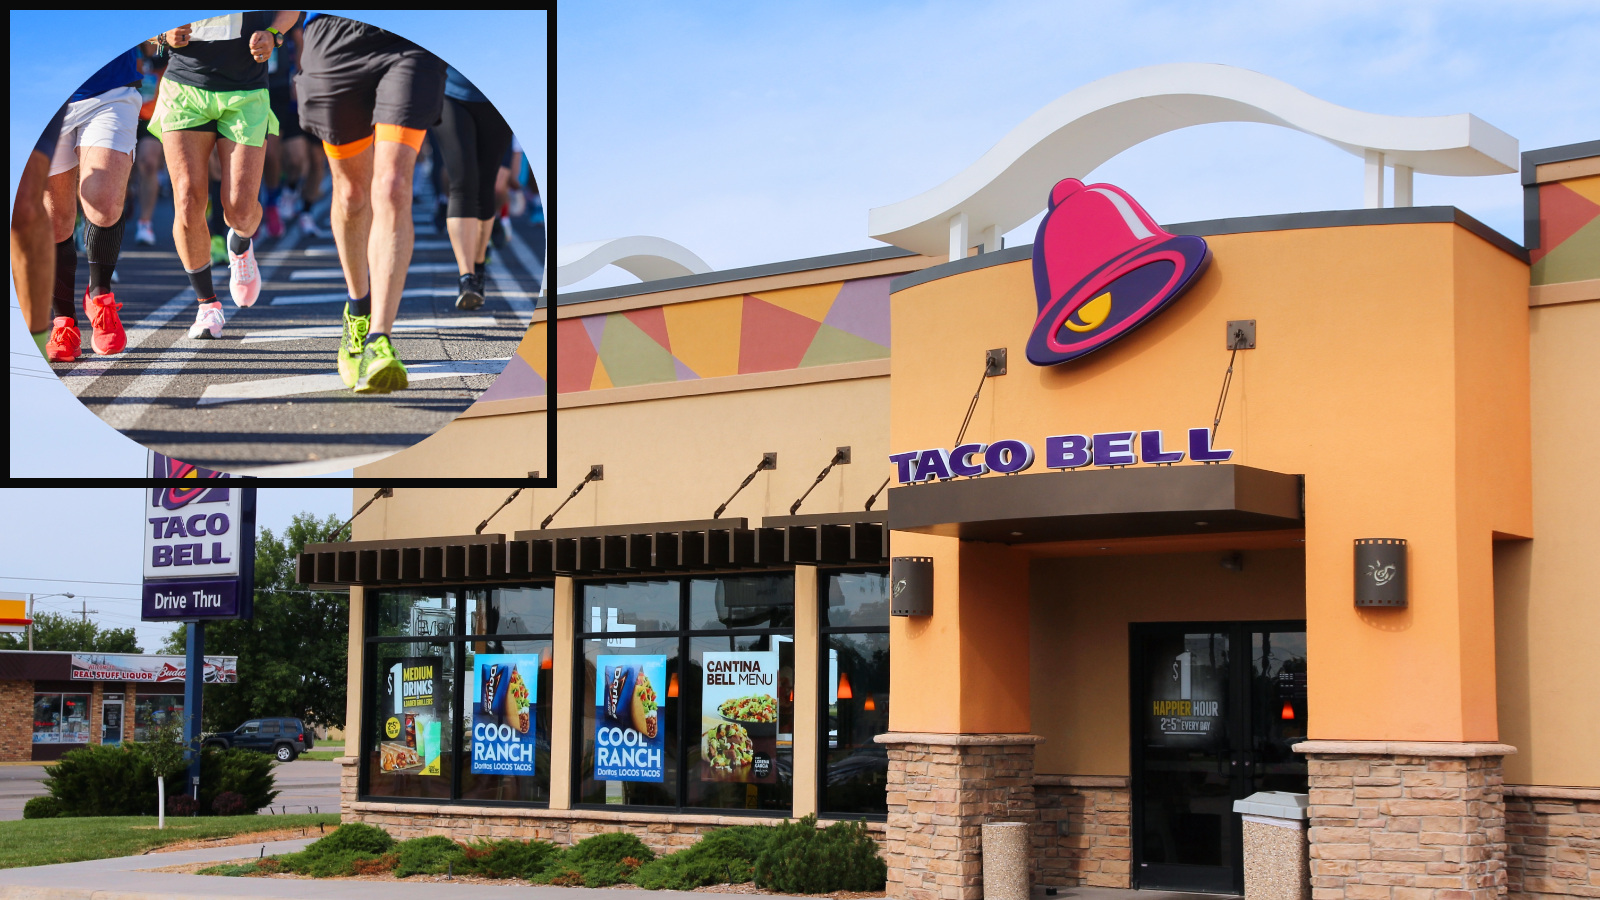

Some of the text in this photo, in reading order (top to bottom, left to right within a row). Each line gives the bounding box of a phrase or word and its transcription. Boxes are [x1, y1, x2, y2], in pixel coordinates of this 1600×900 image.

[889, 427, 1234, 484] TACO BELL
[149, 512, 230, 539] TACO
[152, 542, 231, 567] BELL
[154, 589, 221, 610] Drive Thru
[73, 670, 153, 680] REAL STUFF LIQUOR
[403, 665, 433, 681] MEDIUM
[707, 660, 761, 672] CANTINA
[1172, 651, 1192, 700] $1
[403, 680, 433, 697] DRINKS
[707, 673, 773, 685] BELL MENU
[487, 665, 498, 715] Doritos
[611, 667, 622, 719] Doritos
[1153, 700, 1219, 717] HAPPIER HOUR
[474, 722, 521, 742] COOL
[1181, 720, 1199, 731] EVERY
[1200, 721, 1211, 731] DAY
[597, 726, 648, 747] COOL
[474, 743, 533, 762] RANCH
[597, 748, 661, 768] RANCH
[474, 762, 493, 770] Doritos
[493, 762, 513, 771] LOCOS
[513, 763, 532, 772] TACOS
[597, 767, 661, 778] Doritos LOCOS TACOS
